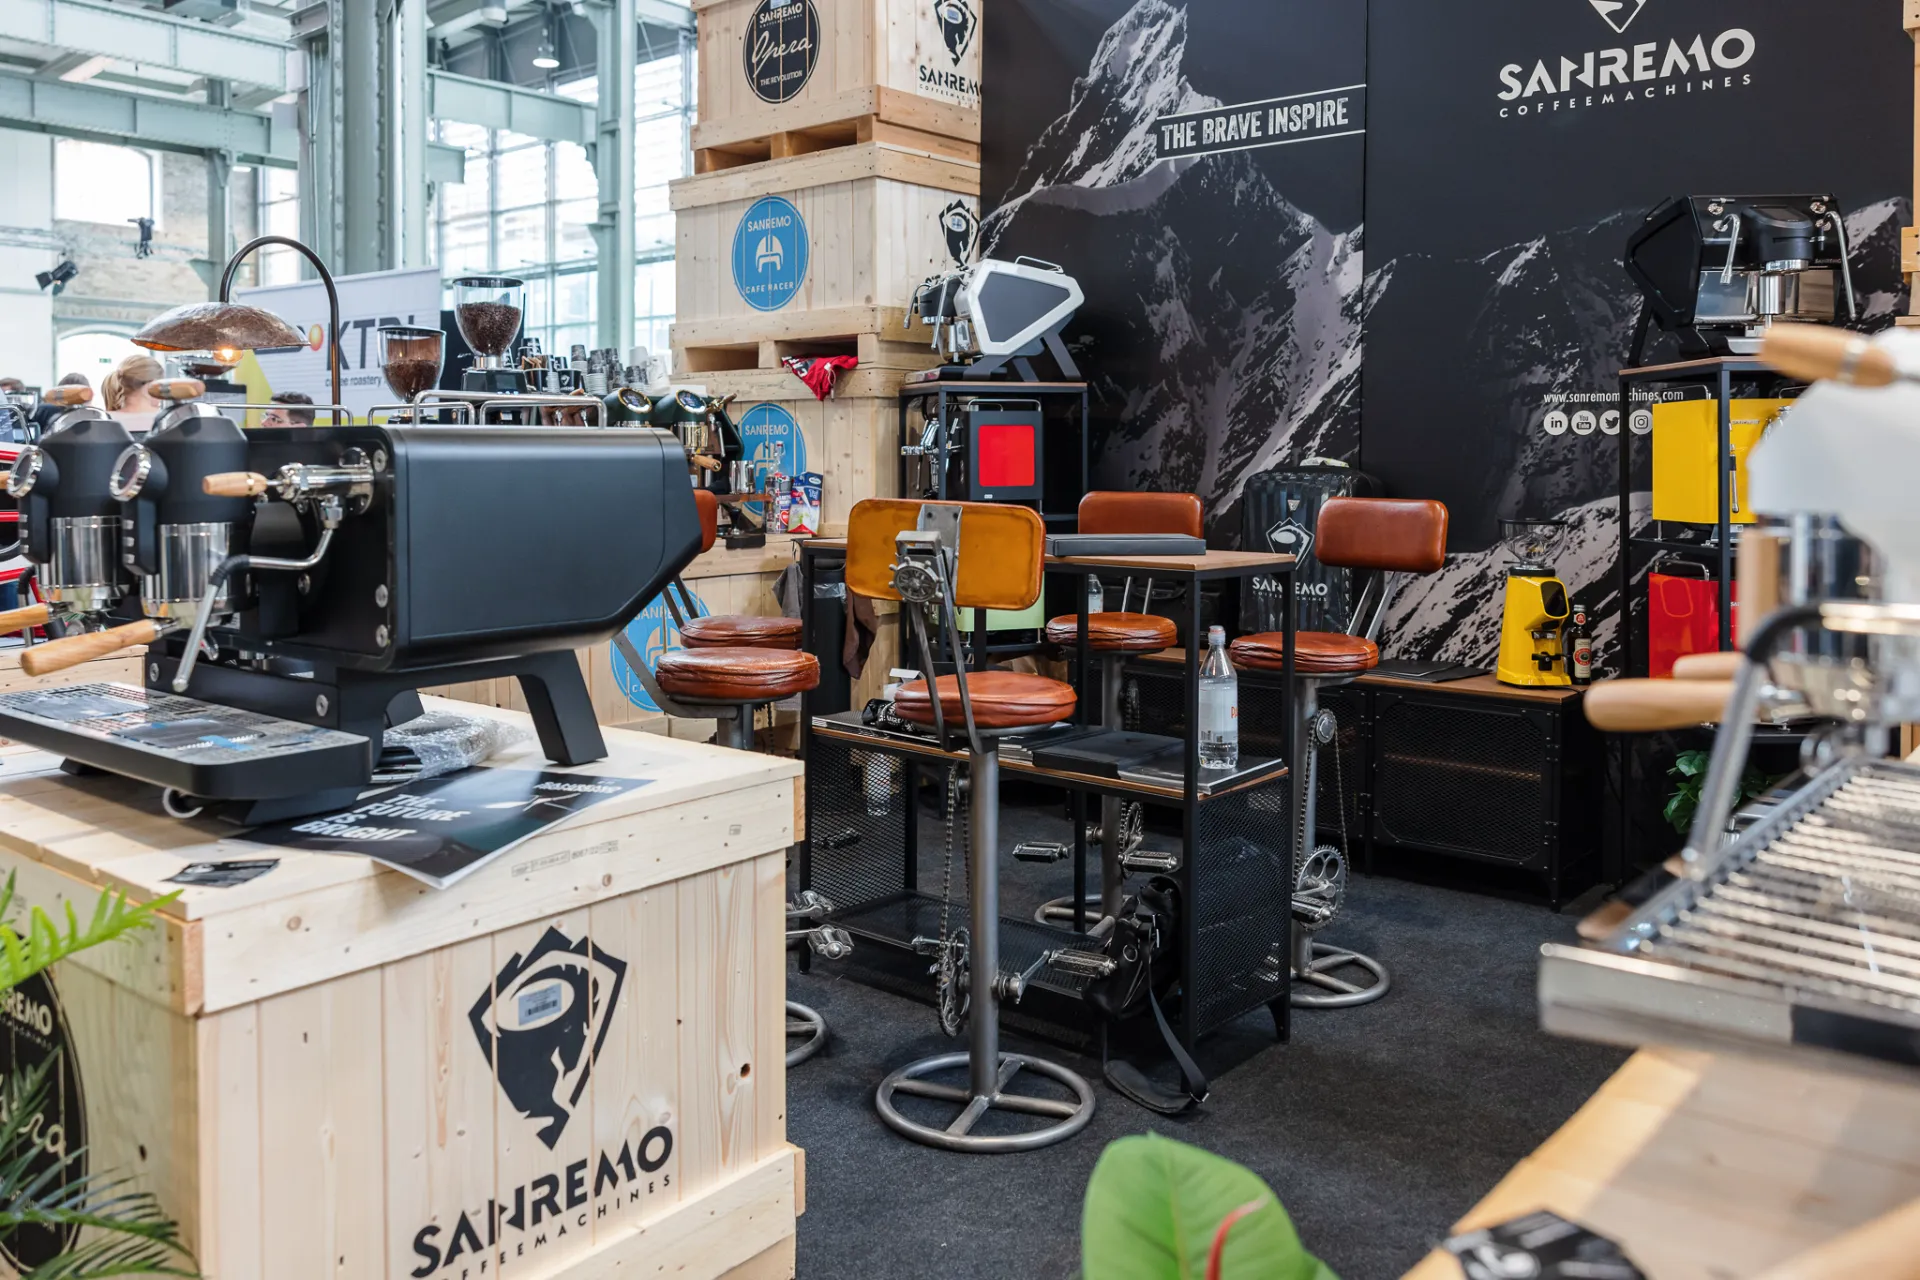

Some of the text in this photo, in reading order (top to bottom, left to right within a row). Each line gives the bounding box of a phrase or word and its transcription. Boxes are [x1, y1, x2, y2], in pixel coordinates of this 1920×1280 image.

[759, 3, 803, 24] SANREMO
[751, 30, 813, 78] Opera
[1497, 28, 1756, 101] SANREMO
[1499, 74, 1752, 118] COFFEEMACHINES
[1161, 97, 1349, 150] THE BRAVE INSPIRE
[747, 215, 792, 232] SANREMO
[745, 281, 794, 294] CAFE RACER
[350, 373, 382, 388] roastery
[745, 424, 789, 435] SANREMO
[1252, 577, 1328, 597] SANEMO
[384, 793, 446, 809] THE
[323, 812, 368, 824] IS
[353, 802, 471, 821] FUTURE
[291, 820, 417, 841] BRIGHT
[411, 1126, 673, 1278] SANREMO
